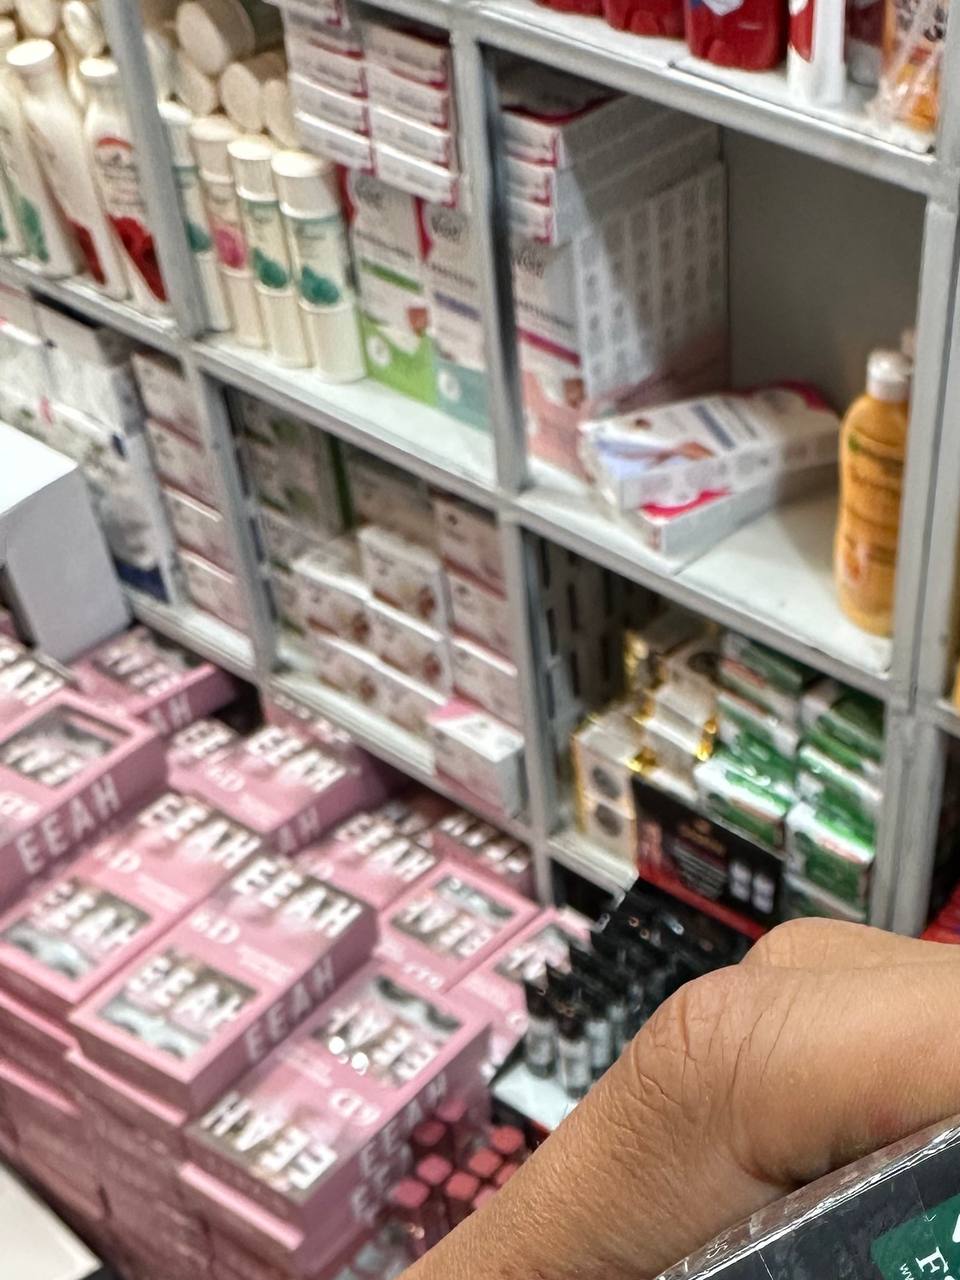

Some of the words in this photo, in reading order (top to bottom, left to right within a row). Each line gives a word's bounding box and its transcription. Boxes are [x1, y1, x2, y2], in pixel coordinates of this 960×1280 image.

[15, 772, 121, 875] EEAH
[137, 792, 262, 870] EEAH
[230, 856, 363, 938] EEAH
[246, 957, 335, 1061] EEAH
[202, 1091, 338, 1190] EEAH
